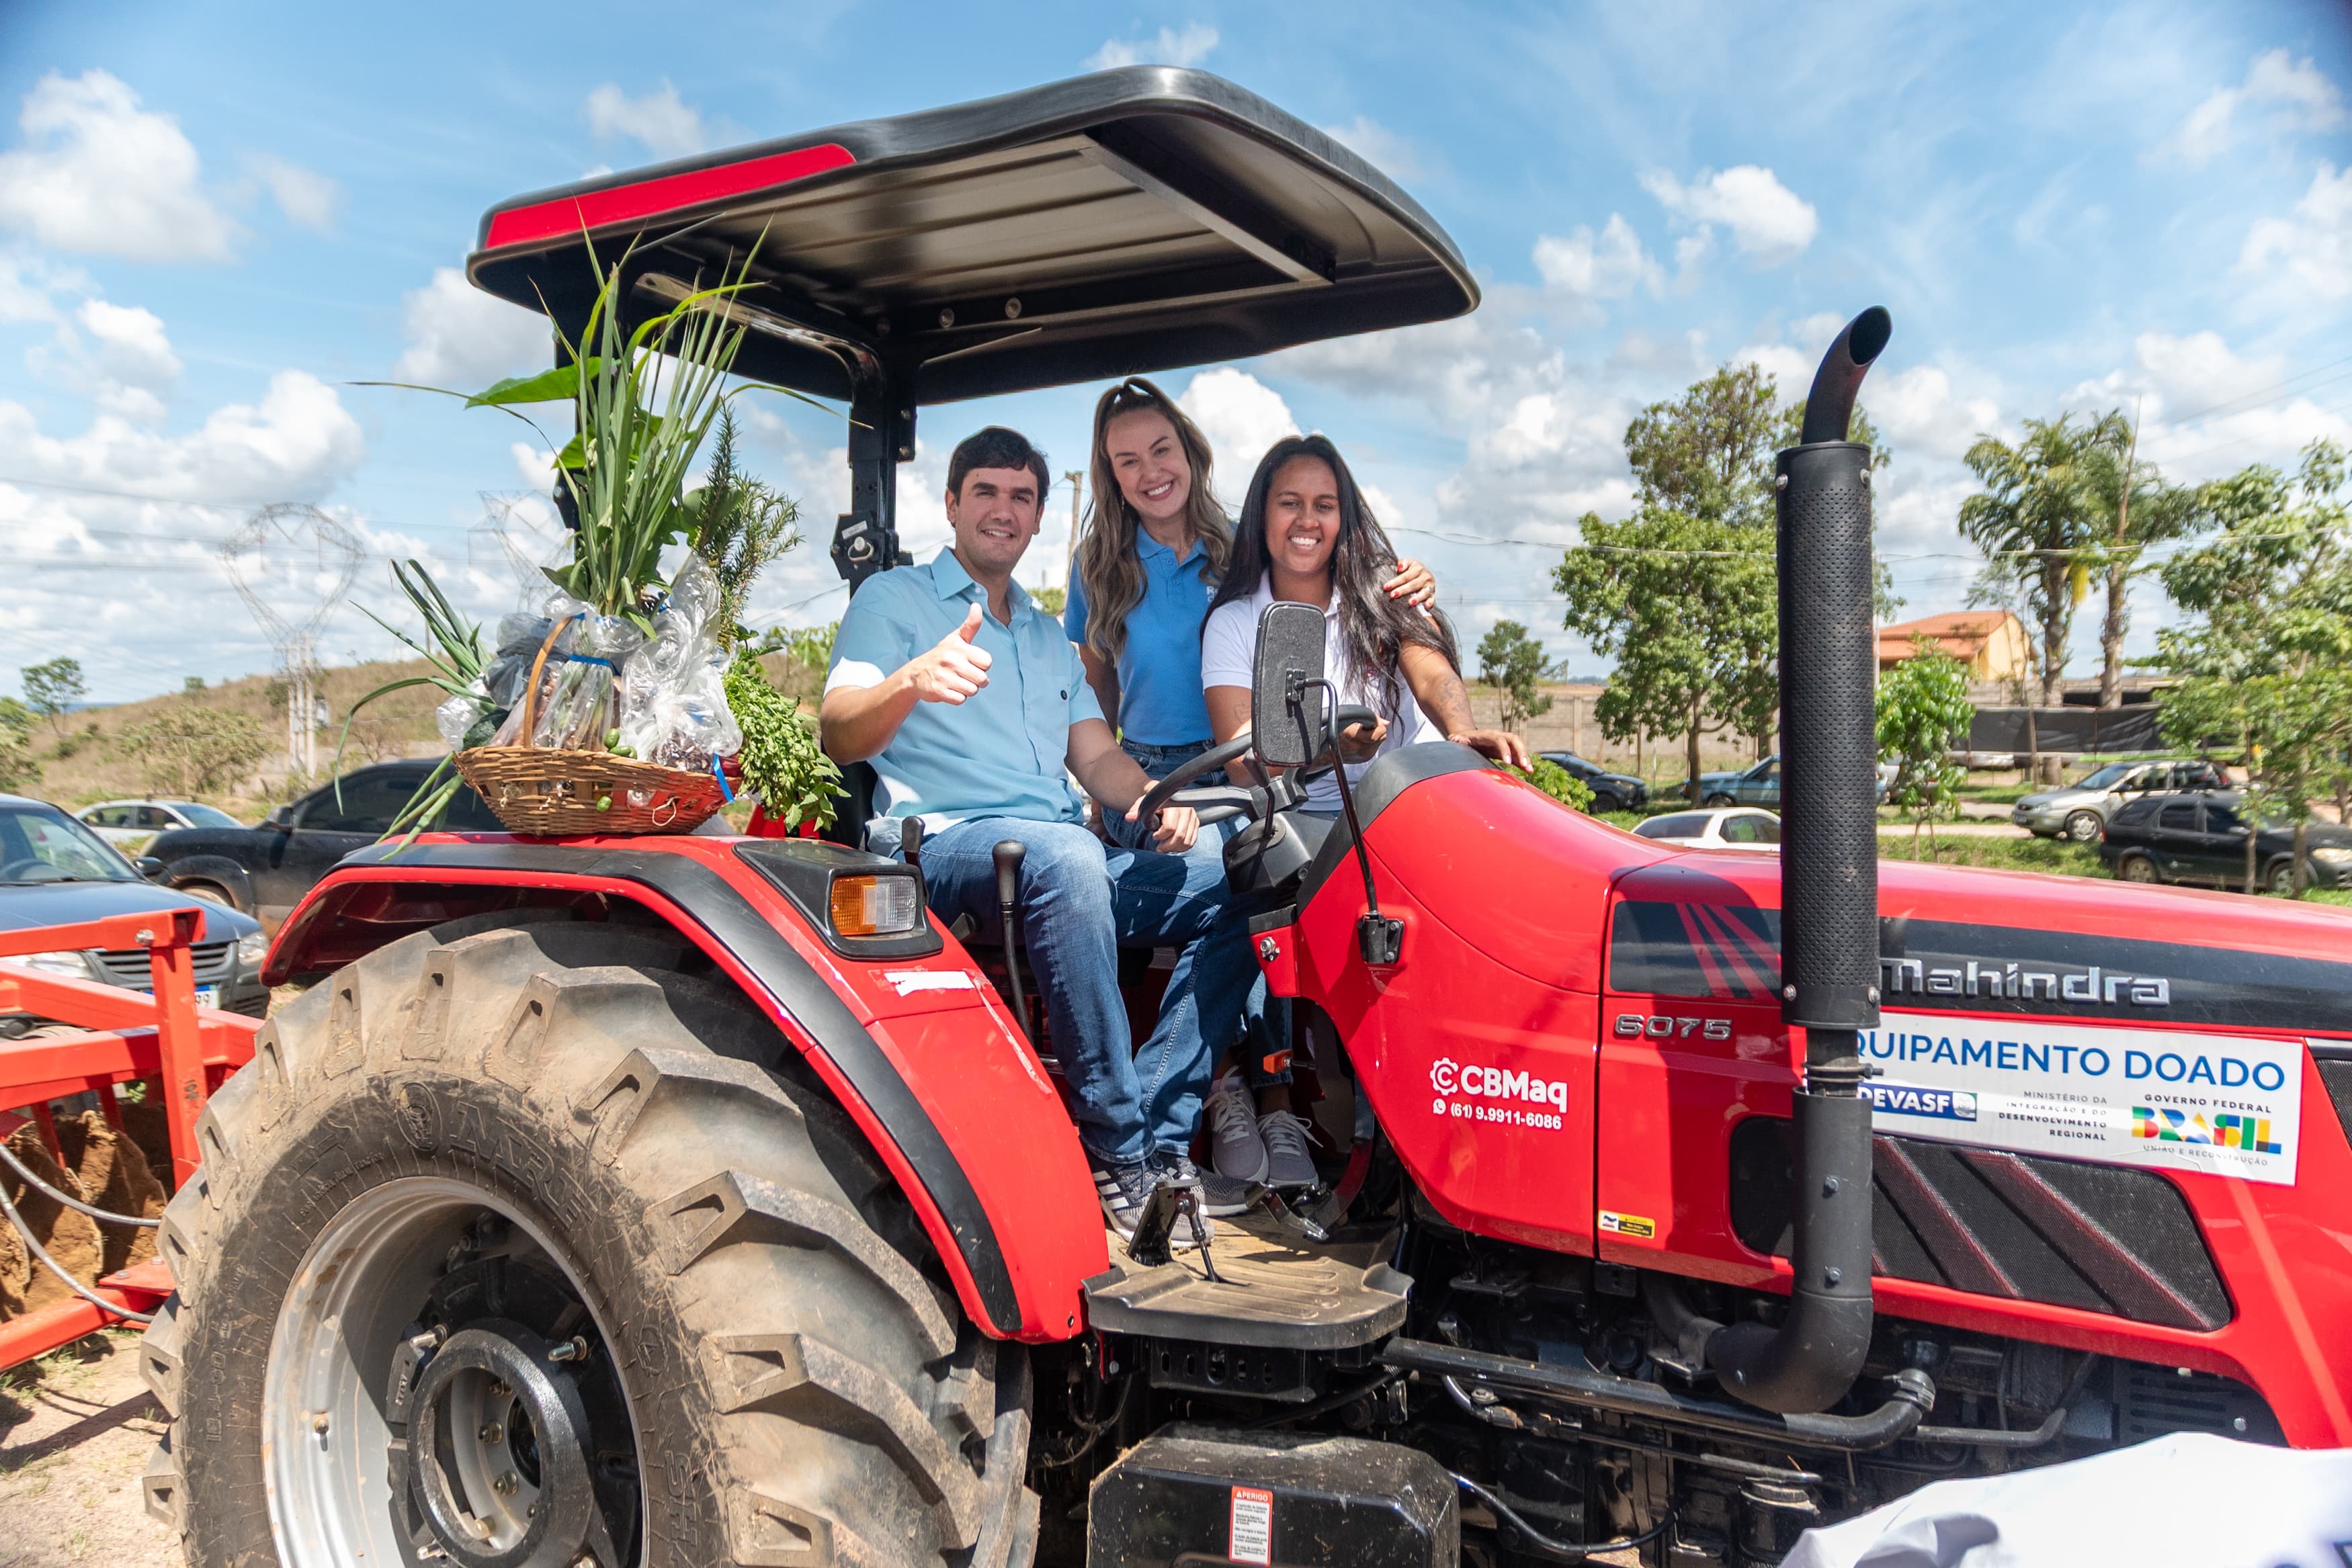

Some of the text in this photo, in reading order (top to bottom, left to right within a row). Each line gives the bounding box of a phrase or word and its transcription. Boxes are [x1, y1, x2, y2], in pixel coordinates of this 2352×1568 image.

[1615, 1014, 1732, 1039] 6075
[2125, 1050, 2285, 1091] DOADO
[1460, 1065, 1568, 1113] CBMaq
[2023, 1090, 2089, 1102] MINISTÉRIO
[2144, 1094, 2272, 1113] GOVERNO FEDERAL
[1450, 1102, 1562, 1130] (61) 9.9911-6086
[1999, 1112, 2107, 1128] DESENVOLVIMENTO
[2050, 1129, 2106, 1141] REGIONAL
[2132, 1106, 2281, 1154] BRASIL
[1243, 1491, 1269, 1502] PERIGO
